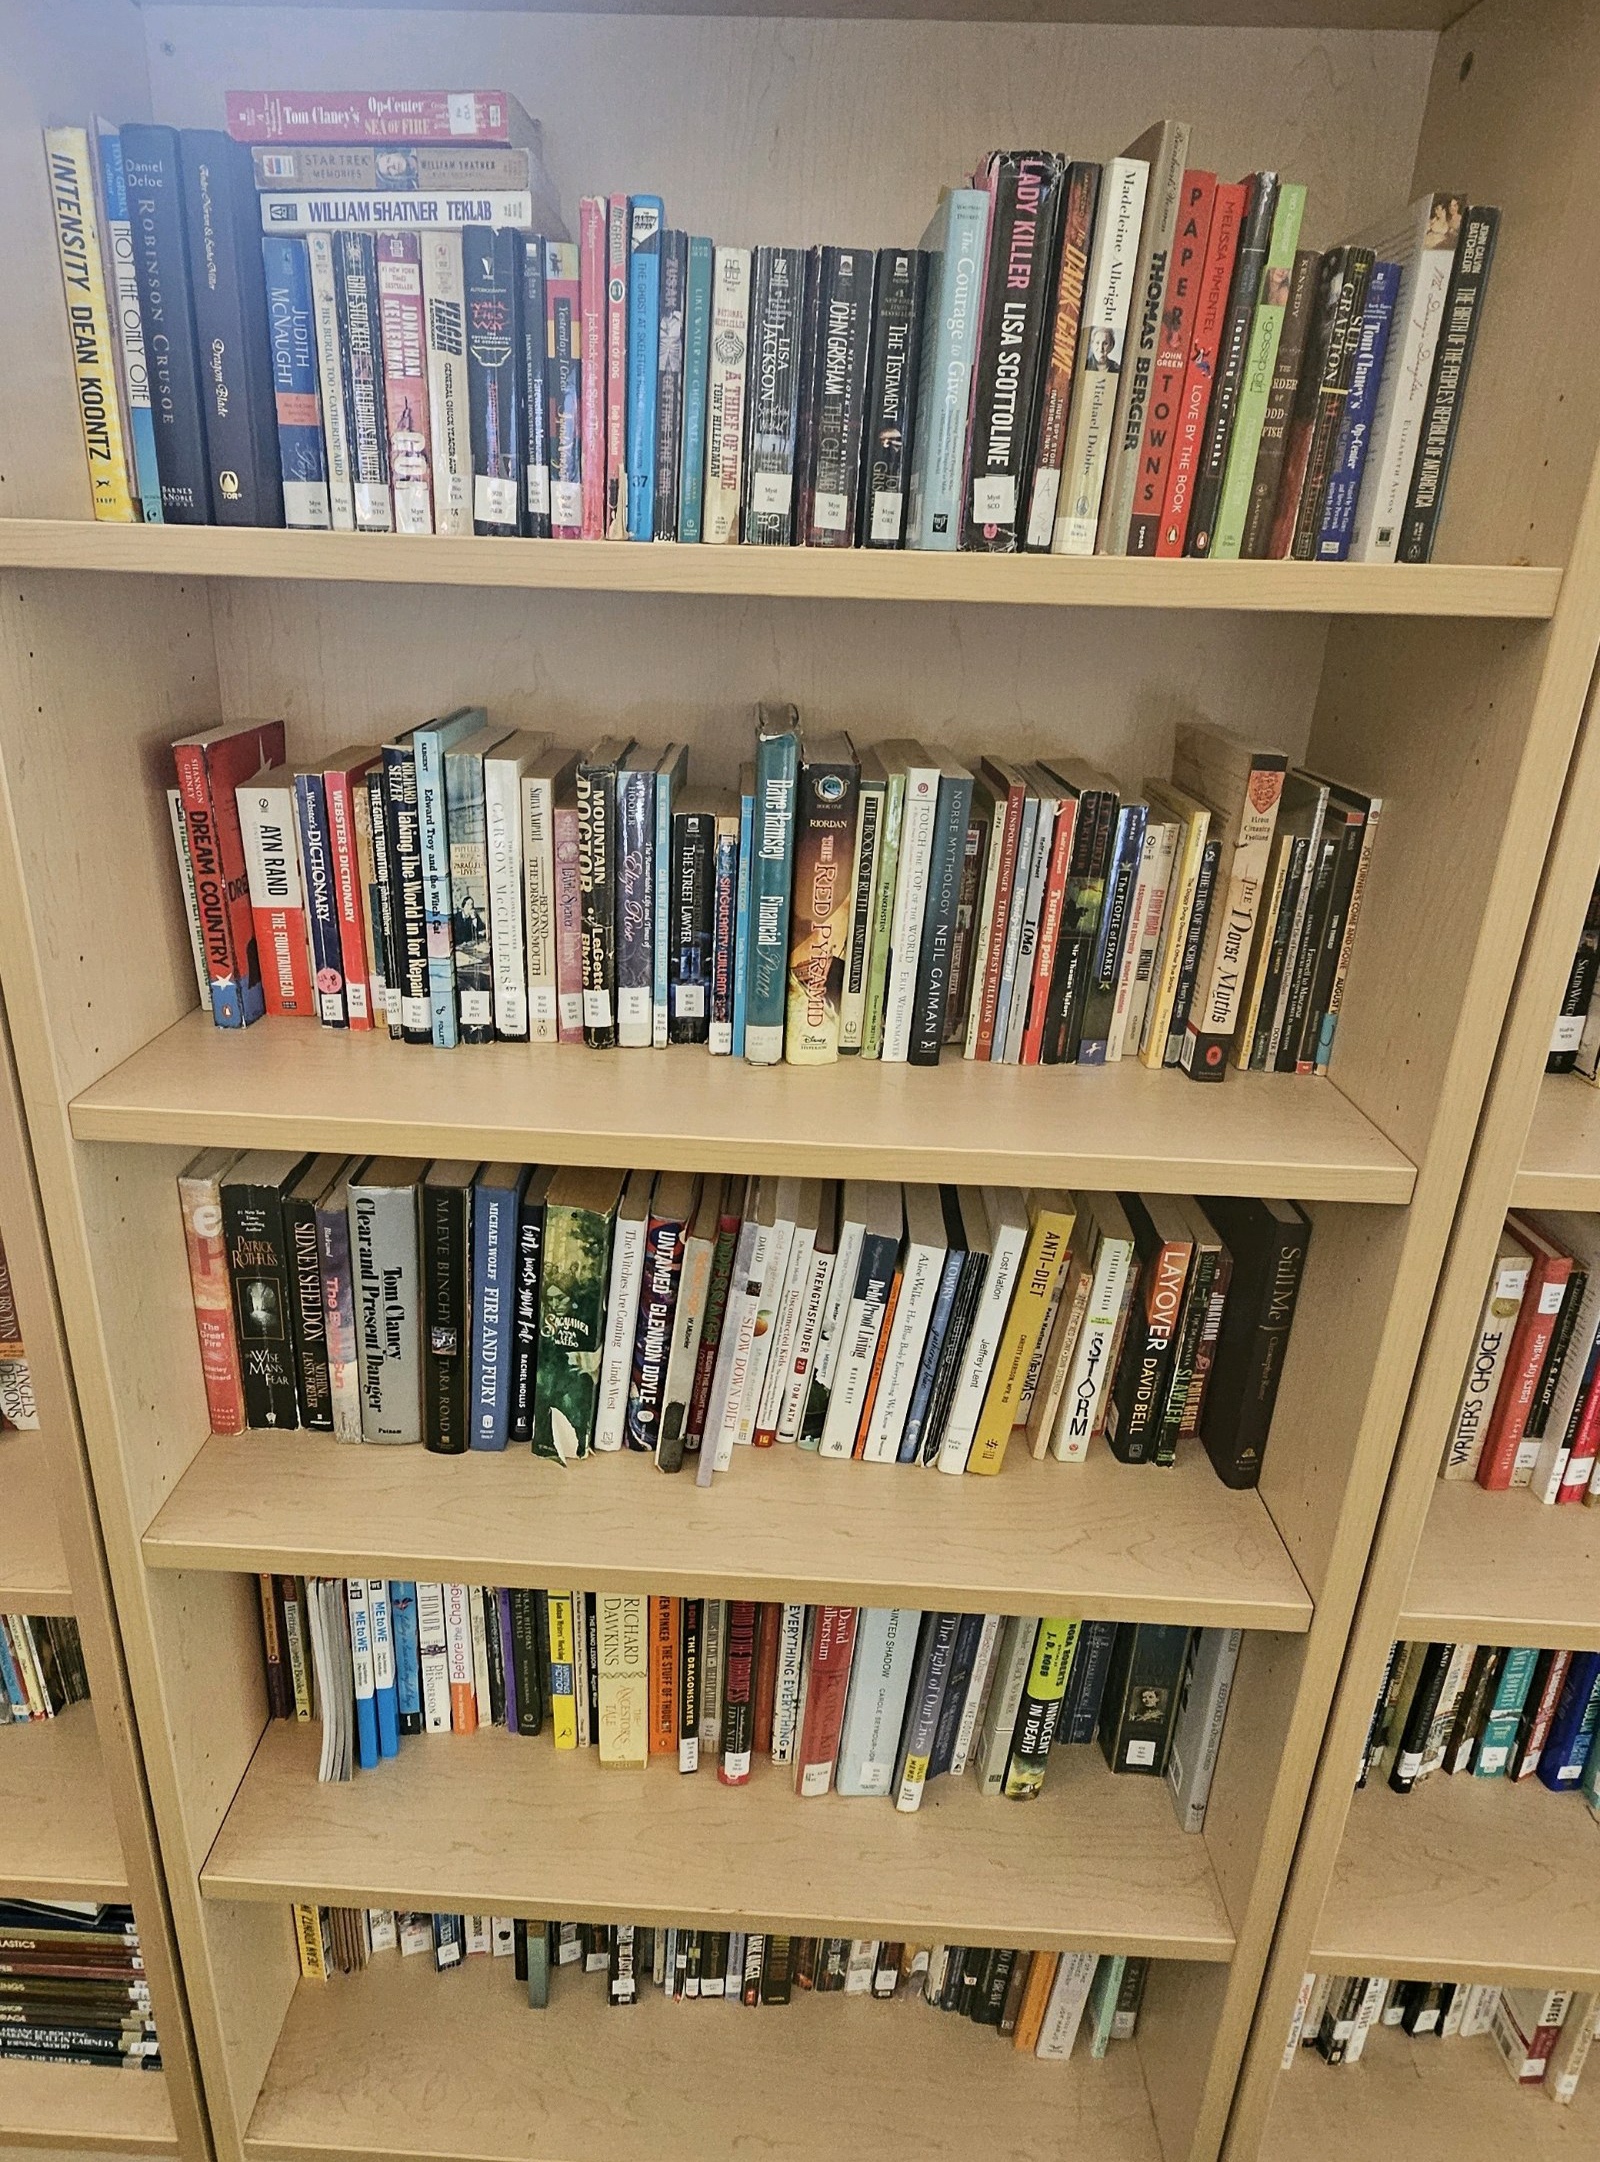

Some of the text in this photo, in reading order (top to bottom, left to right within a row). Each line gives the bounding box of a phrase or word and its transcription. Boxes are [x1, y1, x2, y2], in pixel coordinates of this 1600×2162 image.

[284, 105, 359, 128] Tom Clancy's
[368, 97, 424, 115] Op-Center
[126, 158, 162, 173] Daniel
[128, 172, 162, 187] Defoe
[308, 201, 491, 221] WILLIAM SHATNER TEKLAB
[1104, 170, 1137, 322] Madeleine Albright
[1203, 202, 1236, 333] MELISSA PIMENTEL
[52, 154, 111, 461] INTENSITY DEAN KOONTZ
[139, 200, 173, 424] ROBINSON CRUSOE
[291, 307, 309, 367] JUDITH
[944, 230, 975, 404] The Courage to Give
[986, 160, 1042, 466] LADY KILLER LISA SCOTTOLINE
[761, 320, 778, 400] JACKSON
[778, 337, 790, 370] LISA
[825, 299, 849, 395] JOHN GRISHAM
[882, 324, 908, 421] THE TESTAMENT
[1122, 250, 1167, 451] THOMAS BERGER
[1157, 359, 1183, 368] GREEN
[1160, 351, 1182, 360] JOHN
[711, 382, 723, 478] TONY HILLERMAN
[1172, 385, 1203, 512] LOVE BY THE BOOK
[633, 475, 648, 488] 37
[389, 765, 404, 801] SELZER
[402, 762, 416, 804] RICHARD
[189, 811, 214, 875] DREAM
[307, 790, 331, 921] Webster's DICTIONARY
[576, 779, 592, 893] DOCTOR
[593, 791, 606, 884] MOUNTAIN
[759, 779, 793, 860] Dave Ramsey
[810, 820, 847, 828] RIORDAN
[940, 790, 963, 915] NORSE MYTHOLOGY
[259, 825, 288, 897] AYN RAND
[333, 790, 355, 922] WEBSTER'S DICTIONARY
[856, 798, 878, 914] THE BOOK OF RUTH
[200, 881, 229, 967] COUNTRY
[397, 810, 428, 999] Taking The World in for Repair
[806, 835, 837, 1028] THE RED PYRAMID
[879, 882, 889, 932] FRANKENSTEIN
[1103, 877, 1128, 976] The PEOPLE of SPARKS
[271, 912, 295, 998] THE FOUNTAINHEAD
[581, 933, 590, 987] Blythe
[593, 928, 603, 991] LeGette
[757, 896, 783, 998] Financial Peace
[924, 925, 947, 1034] NEIL GAIMAN
[1212, 879, 1258, 1023] THE Norse Myths
[232, 1250, 278, 1269] ROTHFUSS
[238, 1237, 273, 1252] PATRICK
[436, 1200, 450, 1325] MAEVE BINCHY
[488, 1202, 498, 1279] MICHAEL WOLFF
[652, 1231, 676, 1294] UNTAMED
[992, 1251, 1013, 1300] Lost Nation
[1029, 1231, 1060, 1298] ANTI-DIET
[294, 1222, 324, 1341] SIDNEY SHELDON
[355, 1198, 384, 1412] Clear and Present Danger
[381, 1268, 405, 1360] Tom Clancy
[800, 1260, 827, 1354] STRENGTHSFINDER
[1146, 1252, 1186, 1351] LAYOVER
[1268, 1246, 1300, 1321] Still Me
[200, 1331, 224, 1340] Great
[201, 1323, 219, 1331] The
[204, 1340, 221, 1348] Fire
[250, 1350, 280, 1363] WISE
[479, 1287, 499, 1407] FIRE AND FURY
[639, 1303, 667, 1404] GLENNON DOYLE
[0, 1364, 23, 1418] DEMONS
[15, 1363, 35, 1417] ANGELS
[265, 1374, 289, 1386] FEAR
[970, 1339, 990, 1388] Jeffrey Lent
[1129, 1358, 1157, 1435] DAVID BELL
[1450, 1332, 1502, 1466] WRITER'S CHOICE
[1519, 1334, 1546, 1403] tears for water
[787, 1383, 802, 1423] TOM RATH
[450, 1582, 462, 1626] Change
[604, 1599, 621, 1666] DAWKINS
[624, 1599, 640, 1665] RICHARD
[453, 1650, 466, 1680] Before
[685, 1656, 695, 1725] DRAGONSLAYER
[780, 1605, 801, 1746] EVERYTHING EVERYTHING
[882, 1641, 893, 1678] SHADOW
[1021, 1704, 1043, 1754] IN DEATH
[1037, 1702, 1059, 1754] INNOCENT
